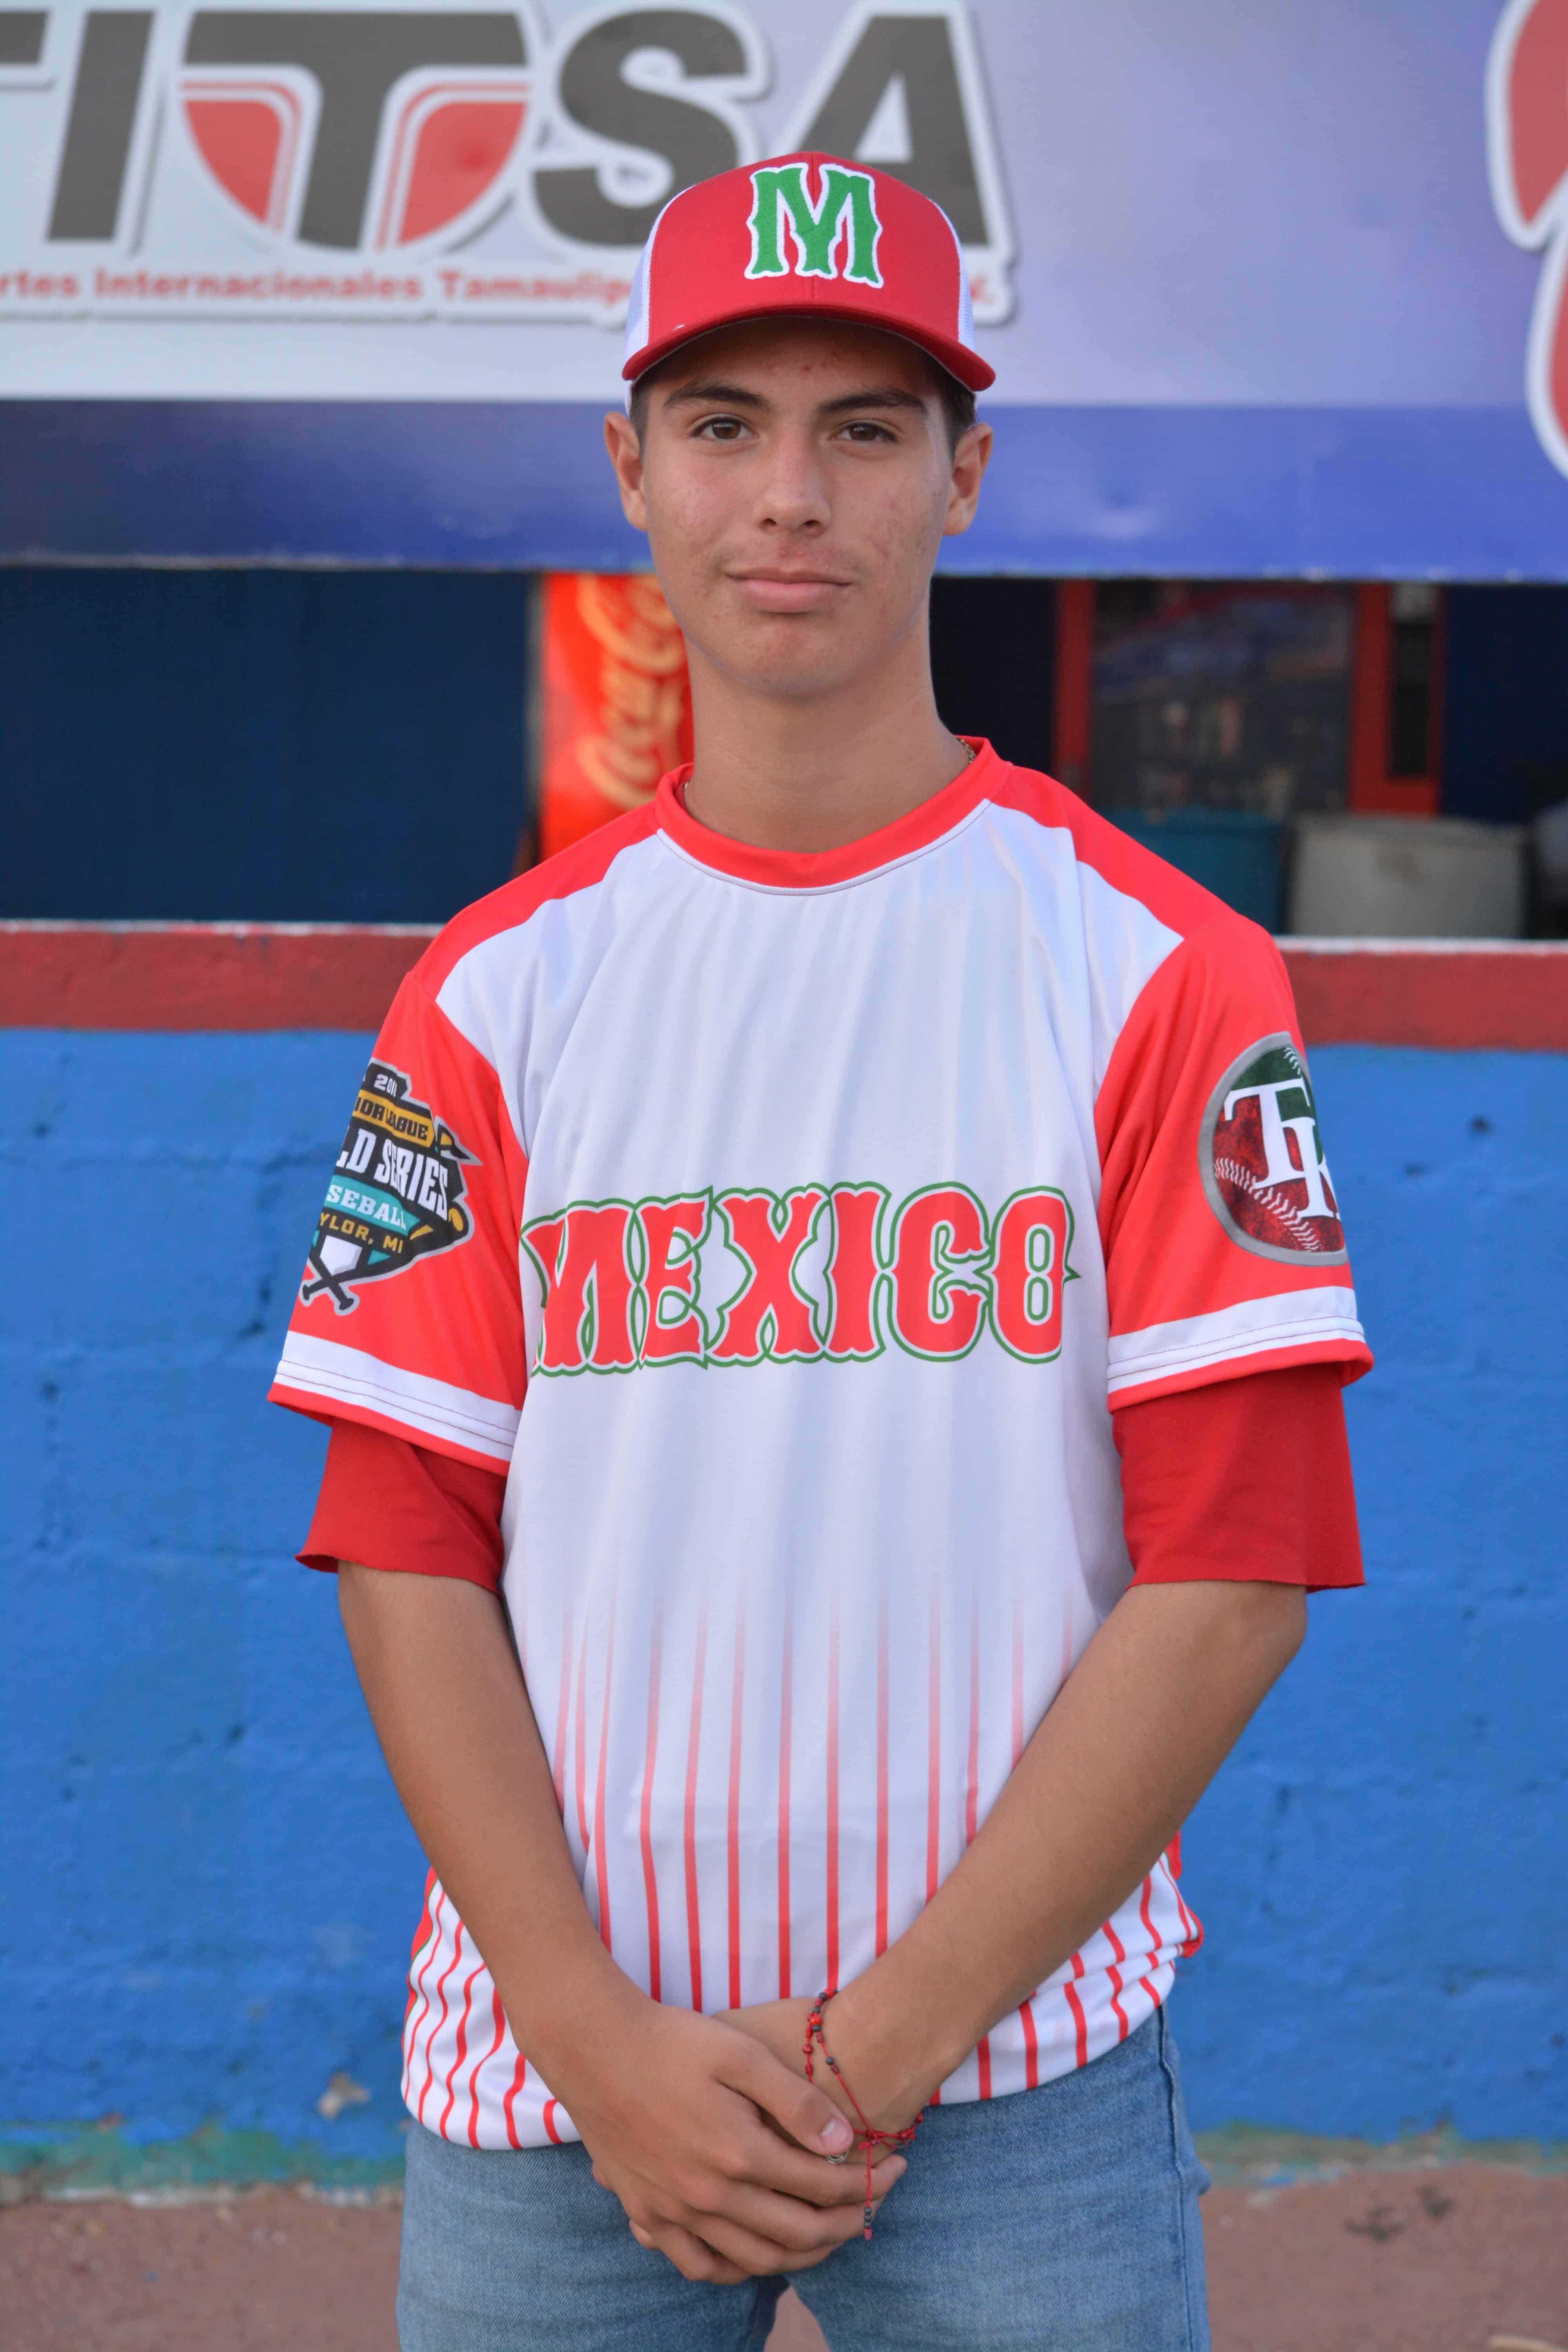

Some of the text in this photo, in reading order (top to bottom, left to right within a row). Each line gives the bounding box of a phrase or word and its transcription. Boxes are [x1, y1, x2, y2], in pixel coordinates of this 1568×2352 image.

[0, 10, 990, 249] ITSA
[744, 162, 884, 289] M
[95, 267, 422, 299] Internacionales
[373, 1138, 448, 1221] SERIES
[383, 1235, 403, 1254] MI
[519, 1182, 1081, 1378] MEXICO
